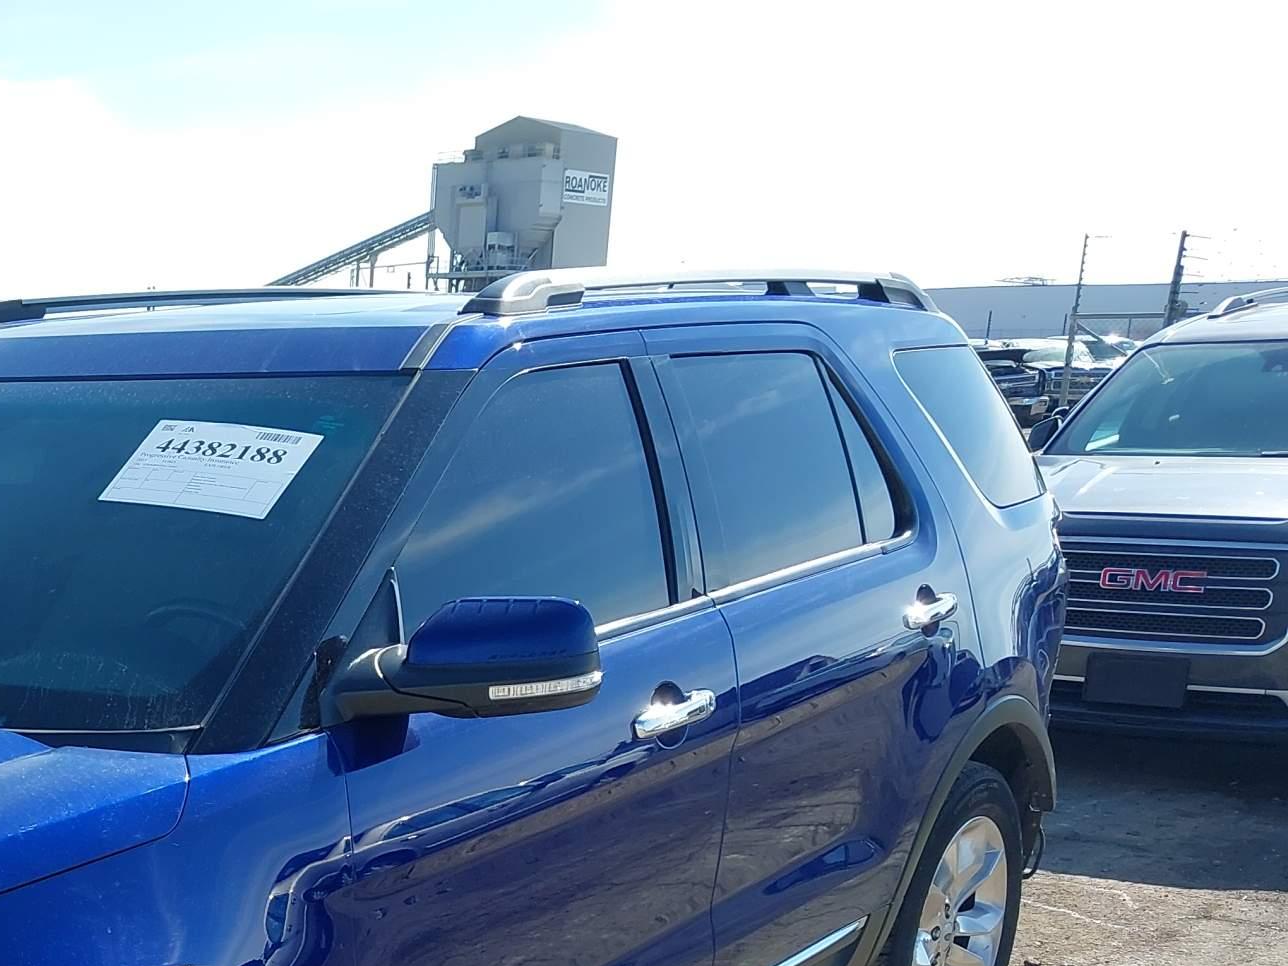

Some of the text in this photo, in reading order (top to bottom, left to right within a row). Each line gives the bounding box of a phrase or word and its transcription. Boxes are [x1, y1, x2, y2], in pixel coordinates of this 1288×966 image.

[565, 175, 608, 193] ROANOKE
[156, 438, 287, 465] 44382188
[1099, 567, 1208, 594] GMC
